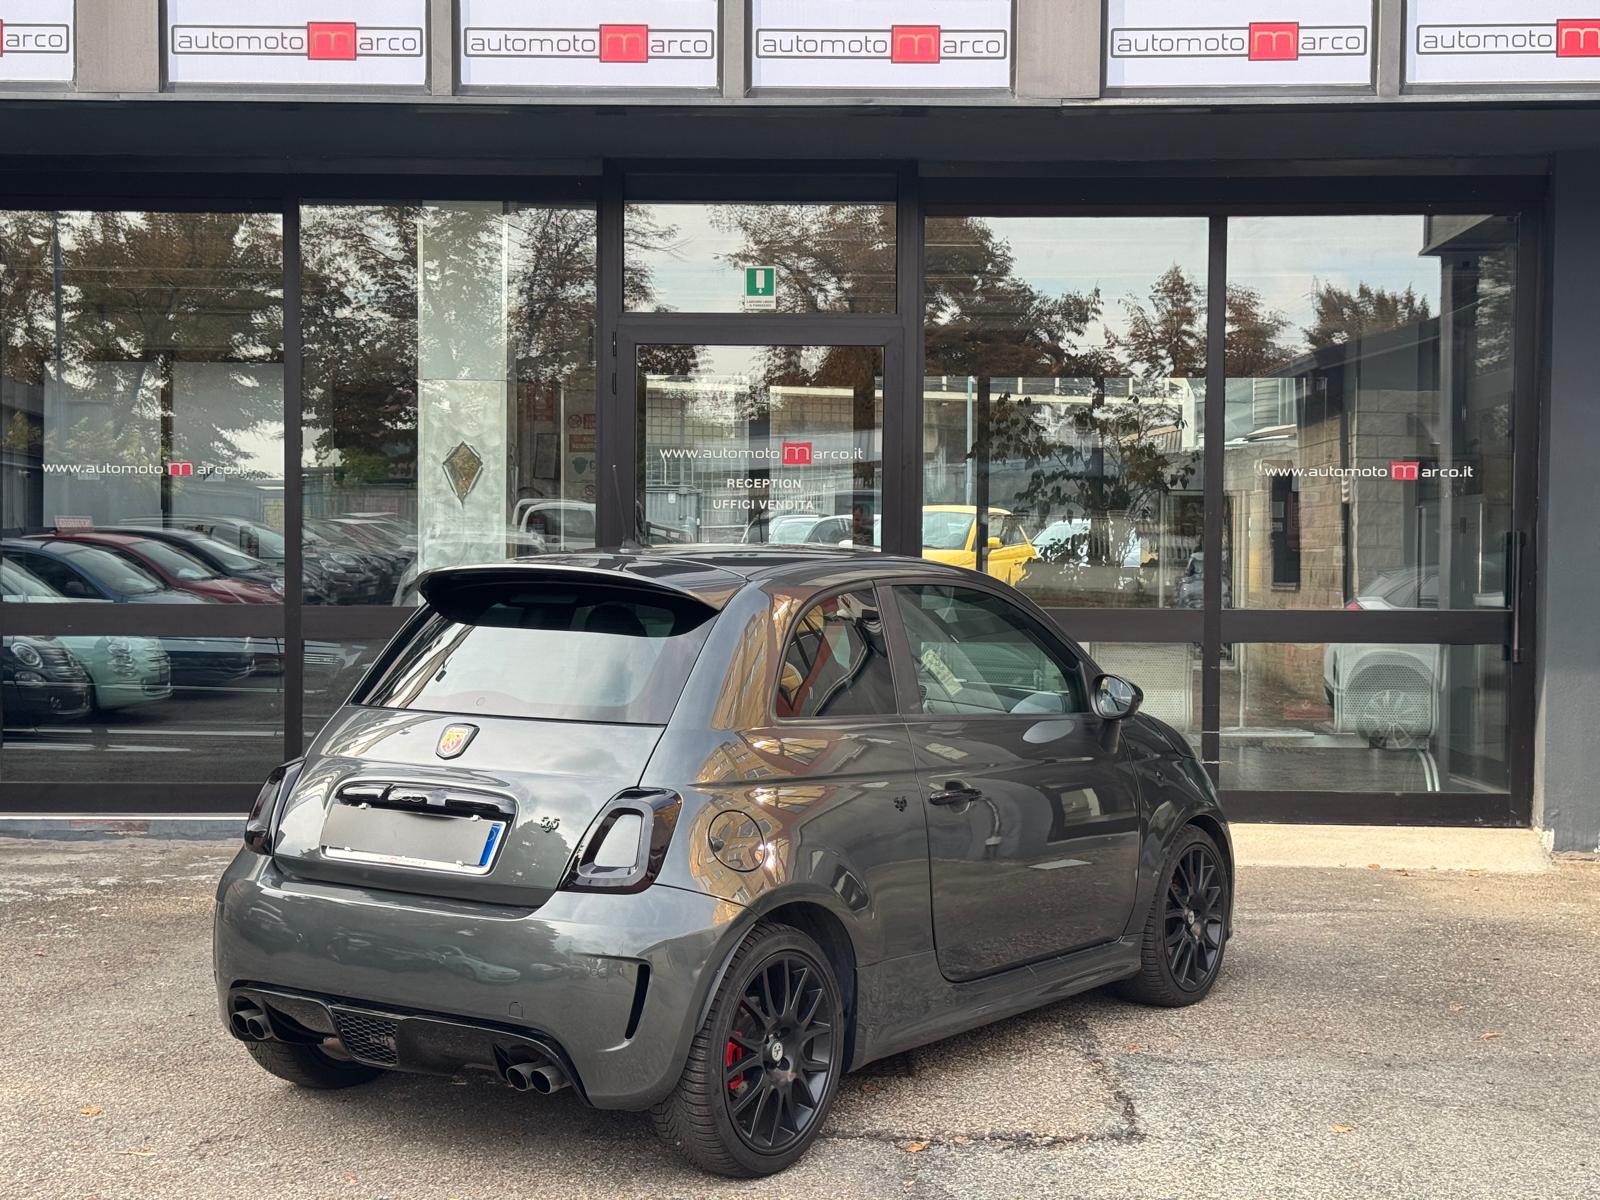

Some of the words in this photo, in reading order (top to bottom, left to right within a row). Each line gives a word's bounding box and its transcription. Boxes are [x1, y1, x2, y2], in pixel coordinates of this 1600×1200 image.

[659, 444, 863, 463] www.automotomarco.it
[1264, 462, 1474, 479] www.automotomarco.it
[726, 478, 801, 489] RECEPTION
[712, 499, 755, 510] UFFICI
[759, 499, 815, 511] VENDITA
